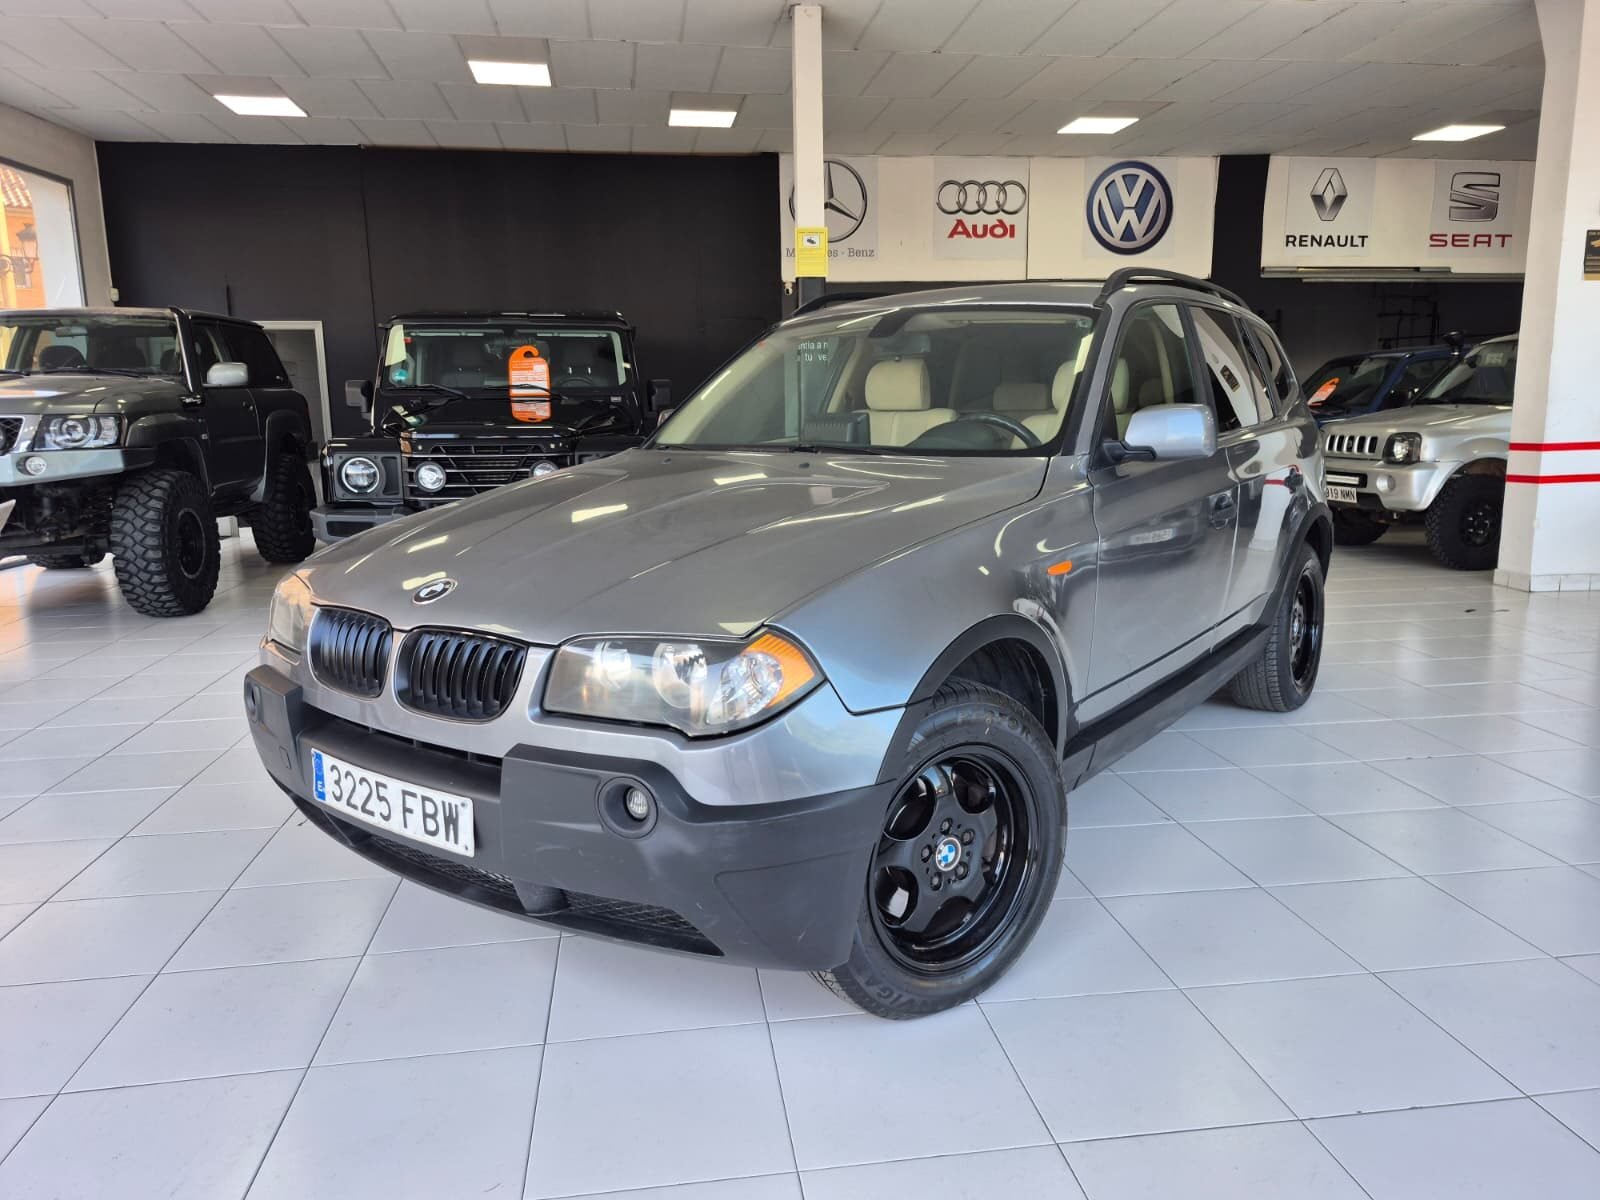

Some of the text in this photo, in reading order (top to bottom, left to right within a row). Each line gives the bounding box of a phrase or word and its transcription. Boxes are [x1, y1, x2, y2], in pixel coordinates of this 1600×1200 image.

[947, 218, 1016, 239] Audi
[1285, 234, 1369, 248] RENAULT
[1429, 233, 1513, 248] SEAT
[847, 247, 875, 258] Benz
[330, 764, 392, 822] 3225
[401, 788, 460, 845] FBW
